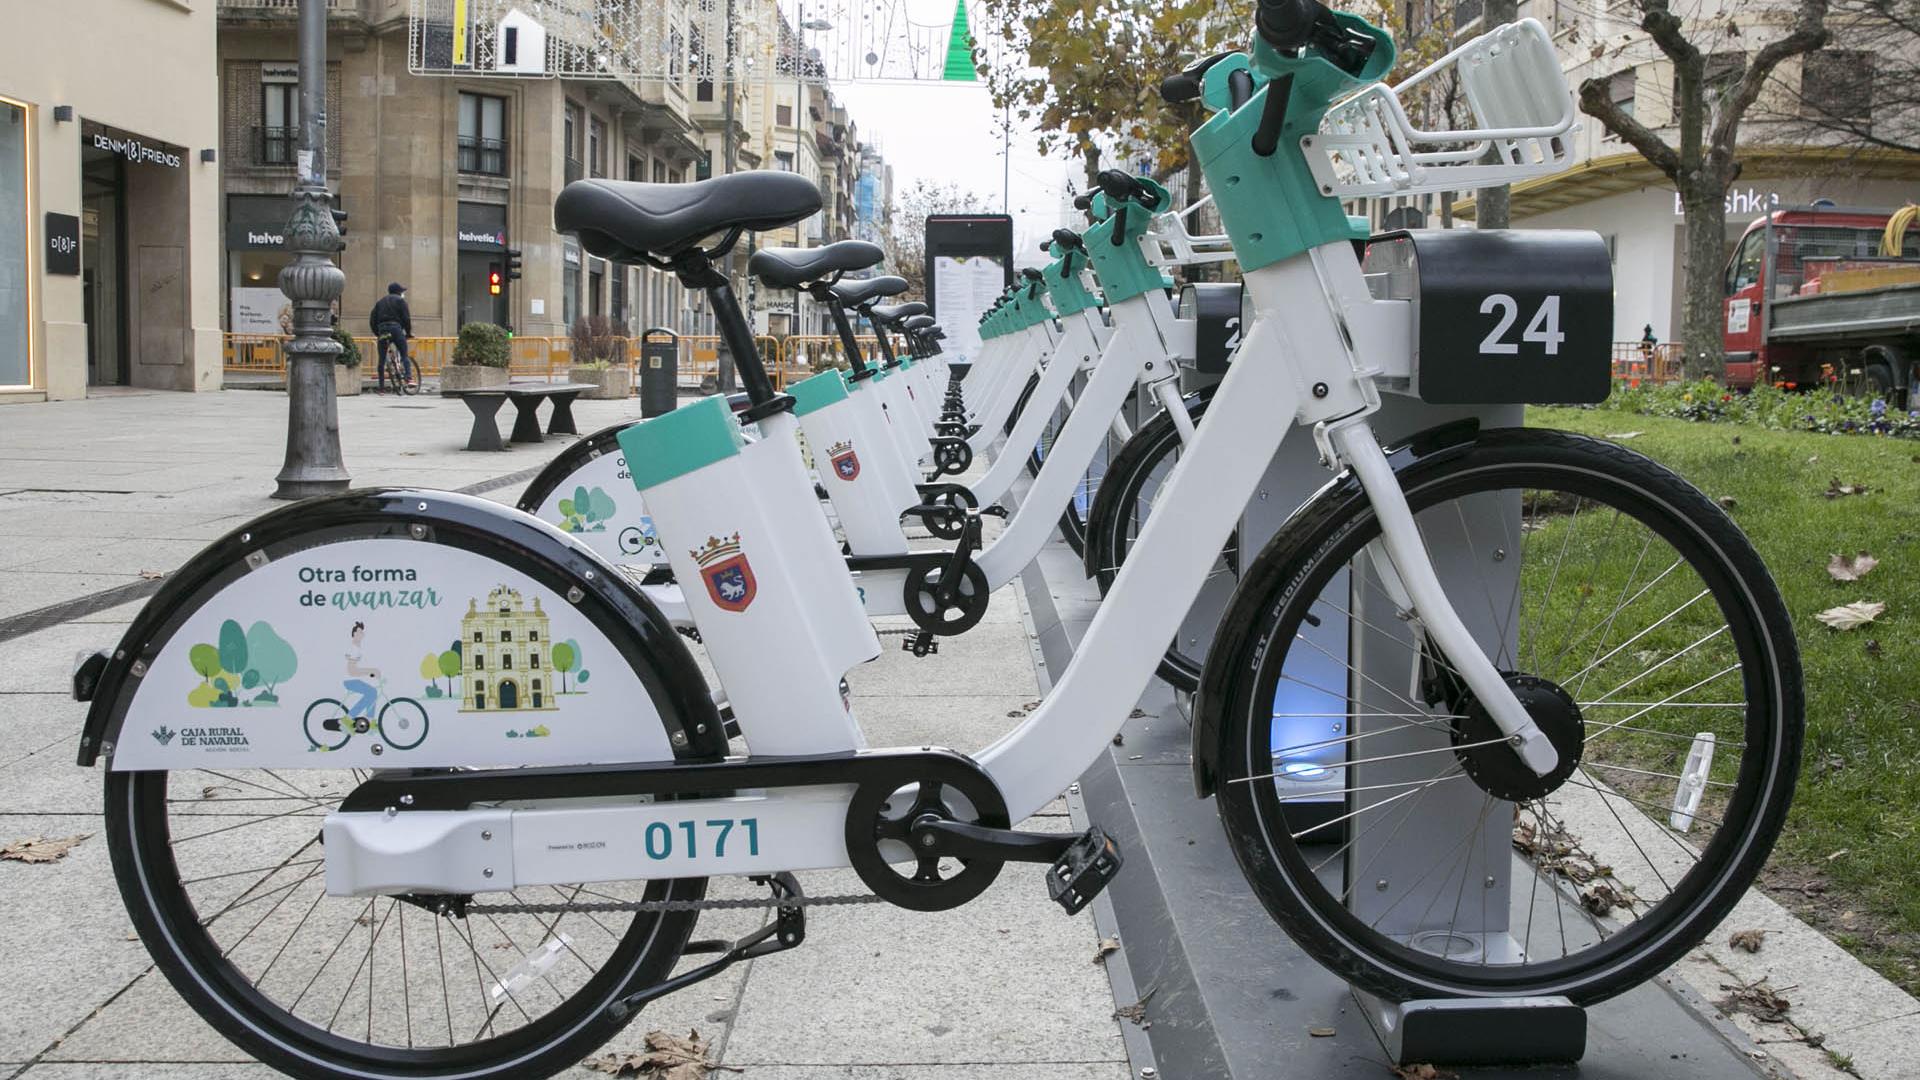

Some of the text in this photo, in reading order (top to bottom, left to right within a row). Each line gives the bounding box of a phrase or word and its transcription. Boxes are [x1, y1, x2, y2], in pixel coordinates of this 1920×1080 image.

[248, 232, 284, 244] helve
[458, 231, 495, 243] helvetia
[1479, 293, 1565, 355] 24
[1225, 317, 1240, 349] 2
[616, 457, 626, 467] O
[617, 470, 632, 479] de
[298, 565, 417, 583] Otra forma
[300, 587, 443, 611] de avanzar
[1251, 634, 1267, 671] CST
[180, 727, 244, 737] CAJA RURAL
[181, 737, 249, 746] DE NAVARRA
[645, 818, 759, 860] 0171
